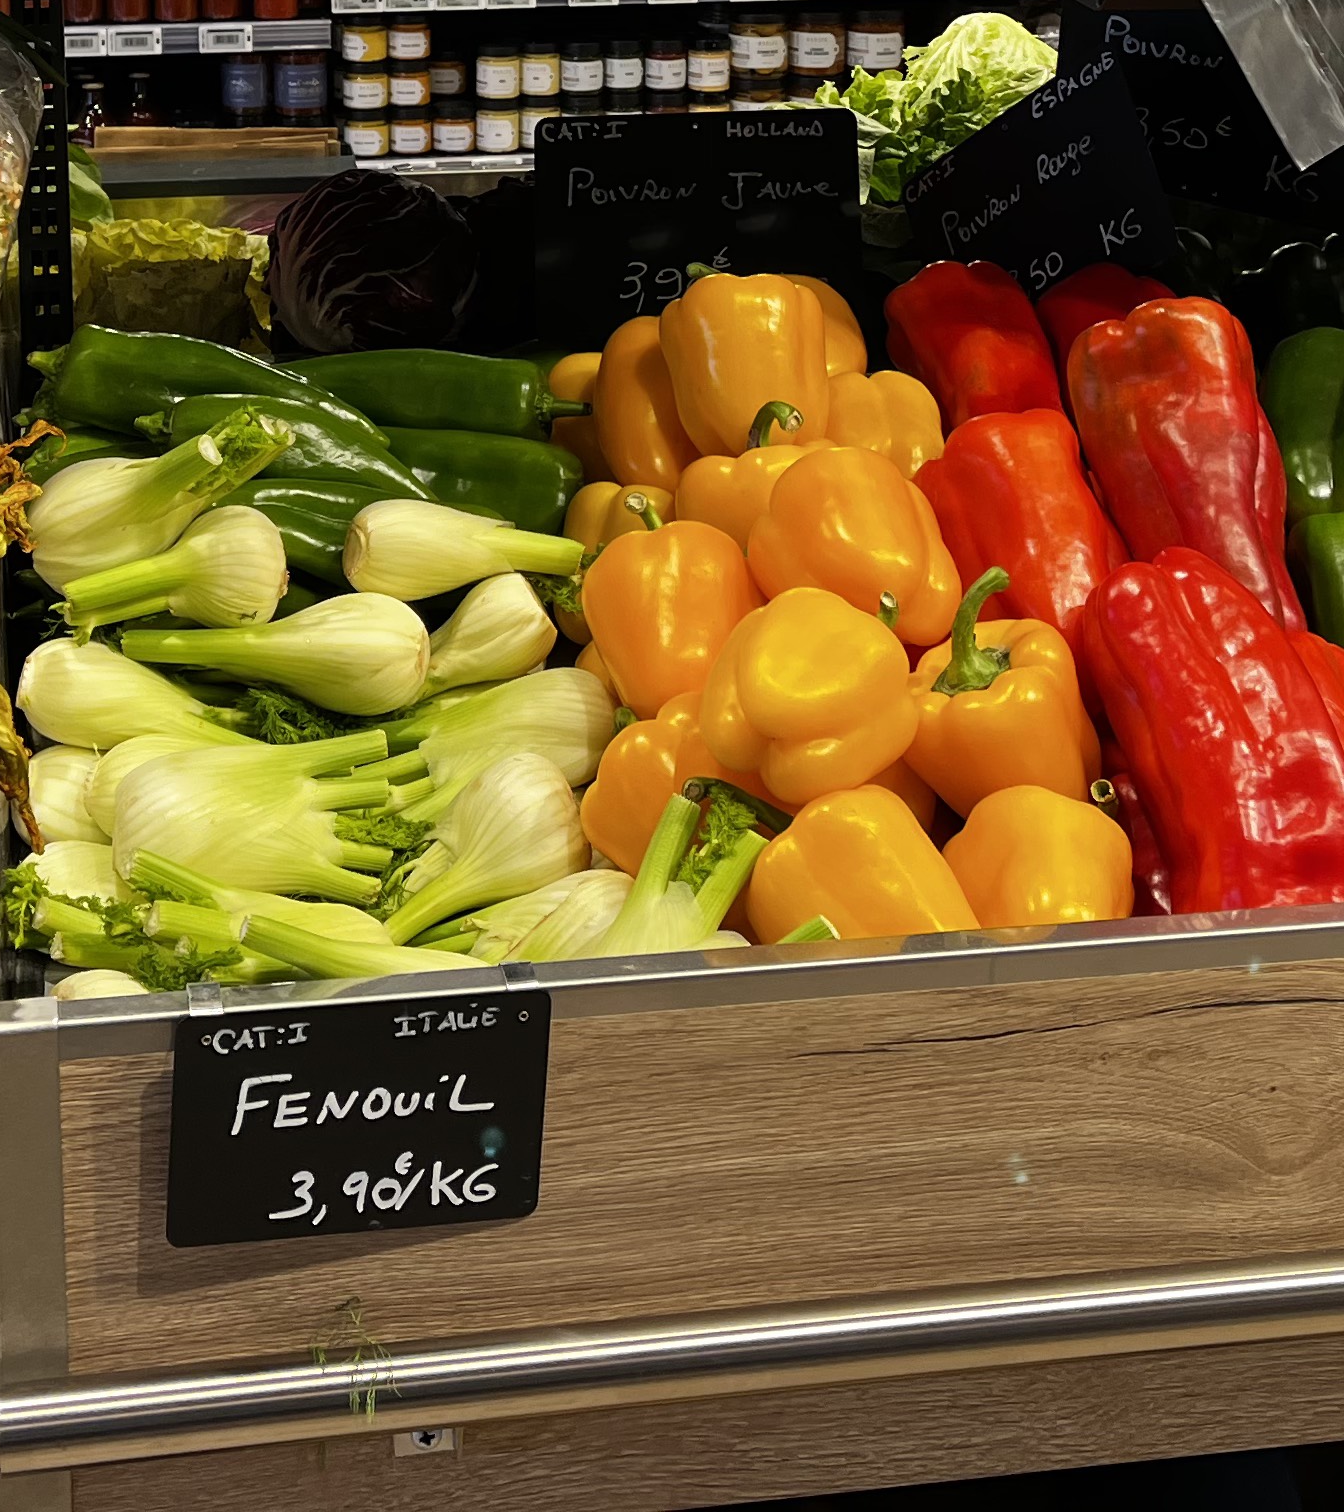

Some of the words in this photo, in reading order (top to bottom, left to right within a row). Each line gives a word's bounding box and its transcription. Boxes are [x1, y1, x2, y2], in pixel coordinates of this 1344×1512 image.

[1031, 51, 1116, 120] ESPAGNE
[726, 119, 824, 139] HOLLAND
[1098, 207, 1143, 256] KG
[619, 246, 732, 315] 3,9€
